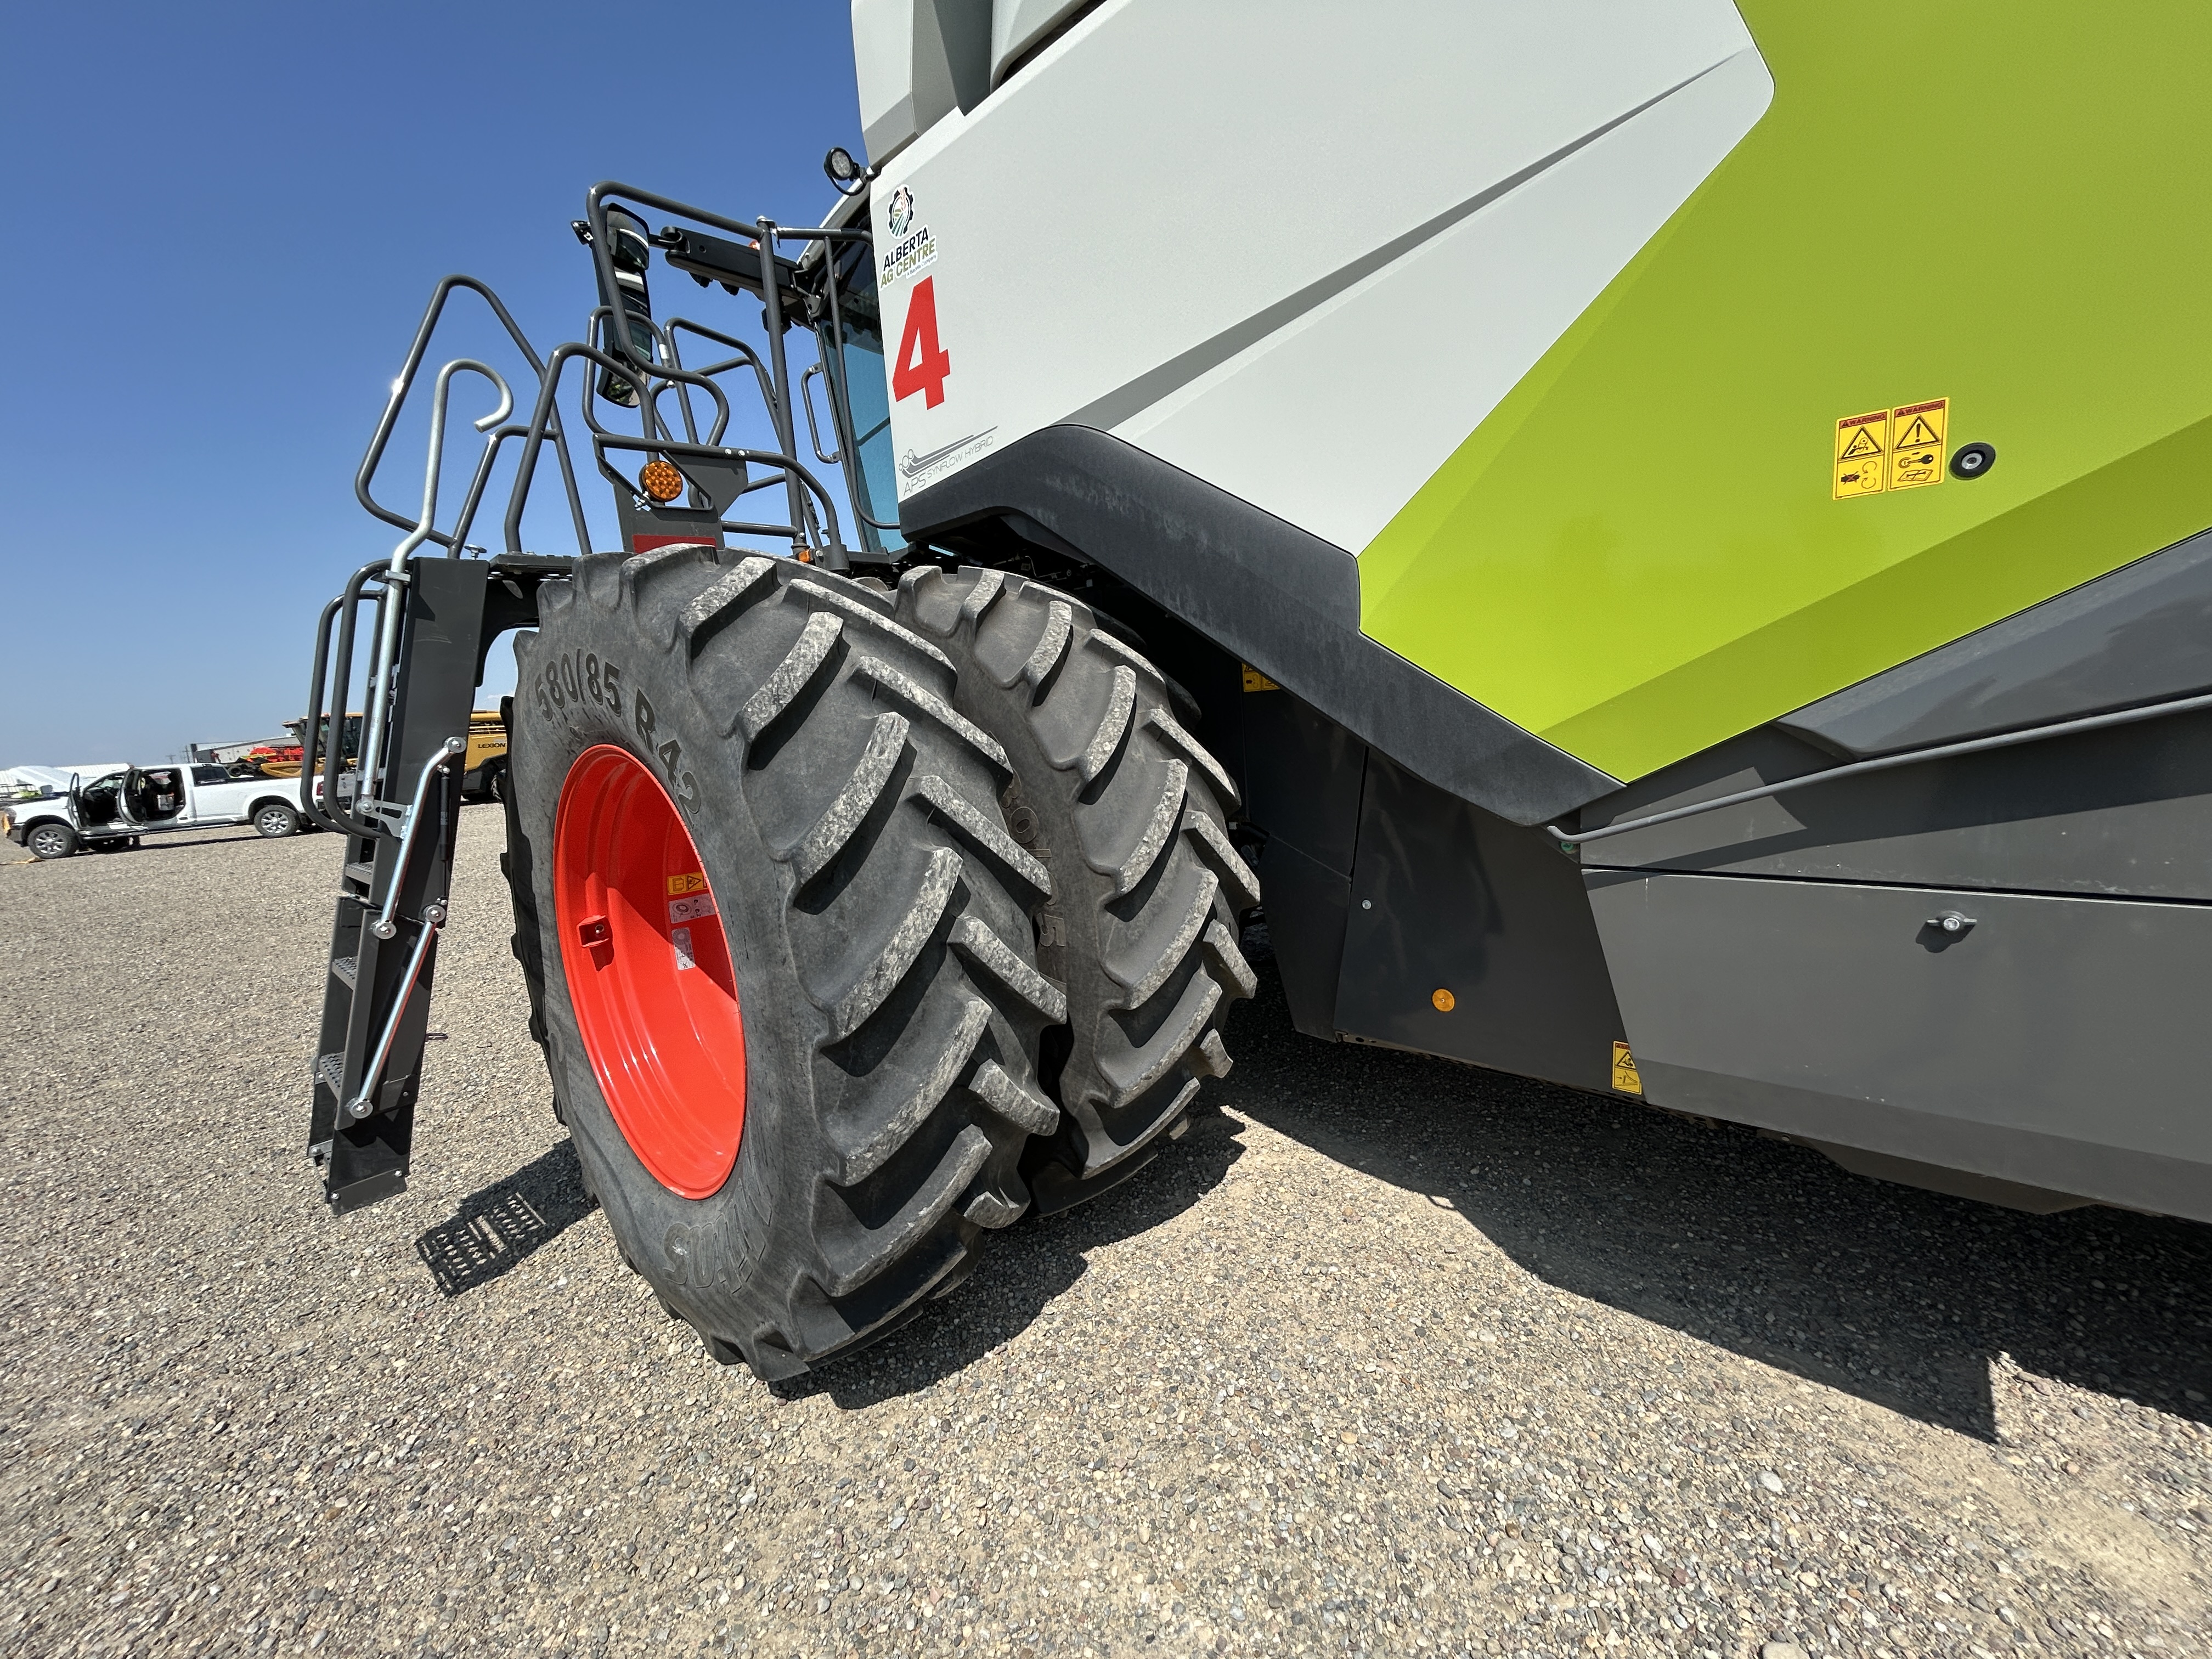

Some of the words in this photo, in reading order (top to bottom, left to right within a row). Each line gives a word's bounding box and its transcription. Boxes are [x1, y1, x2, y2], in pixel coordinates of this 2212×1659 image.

[881, 268, 893, 289] AG
[896, 238, 935, 276] CENTRE
[883, 227, 929, 272] ALBERTA
[892, 274, 951, 410] 4
[1849, 414, 1885, 425] WARNING
[1905, 402, 1944, 414] WARNING
[903, 472, 927, 496] APS
[926, 452, 964, 478] SYNFLOW
[964, 436, 994, 458] HYBRID
[534, 648, 622, 721] 580/85
[635, 687, 656, 754] R
[658, 738, 702, 830] 42
